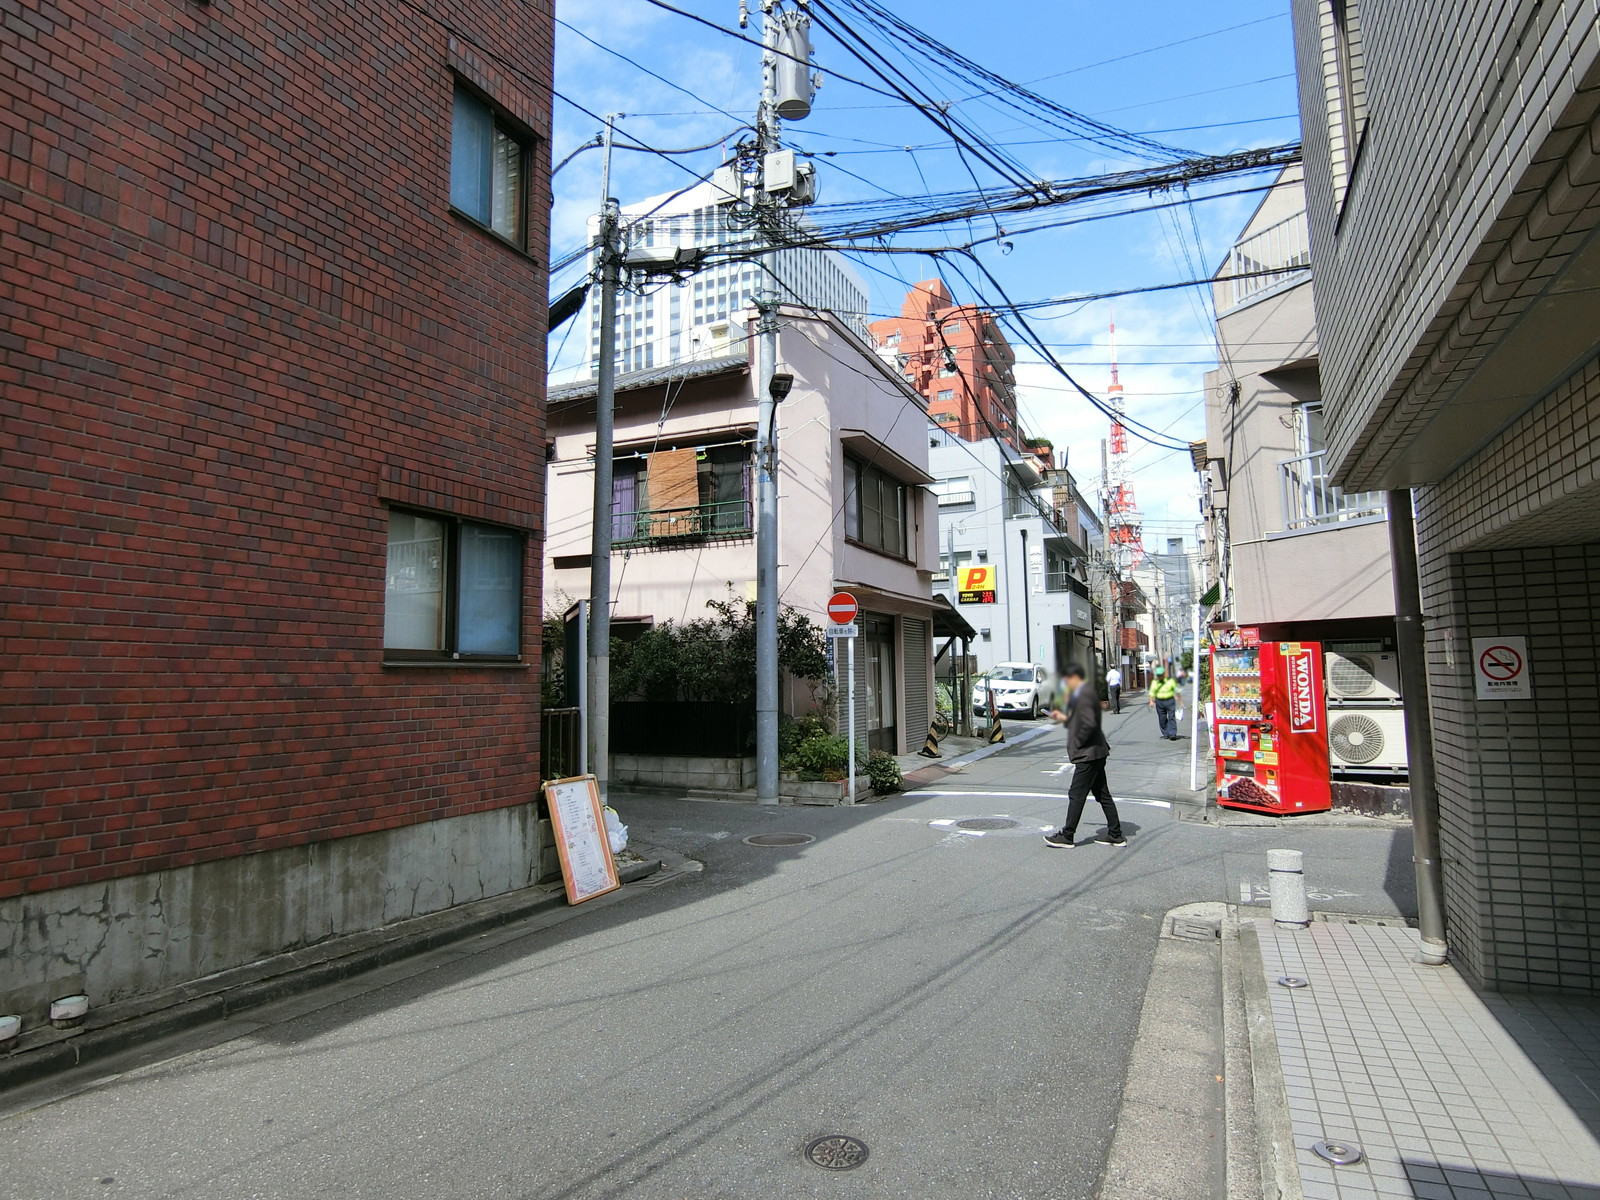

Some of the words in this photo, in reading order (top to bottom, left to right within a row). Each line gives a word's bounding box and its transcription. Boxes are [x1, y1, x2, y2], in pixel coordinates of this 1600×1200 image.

[965, 568, 987, 590] P
[828, 627, 857, 636] 自転車を除く
[1296, 656, 1312, 726] WONDA
